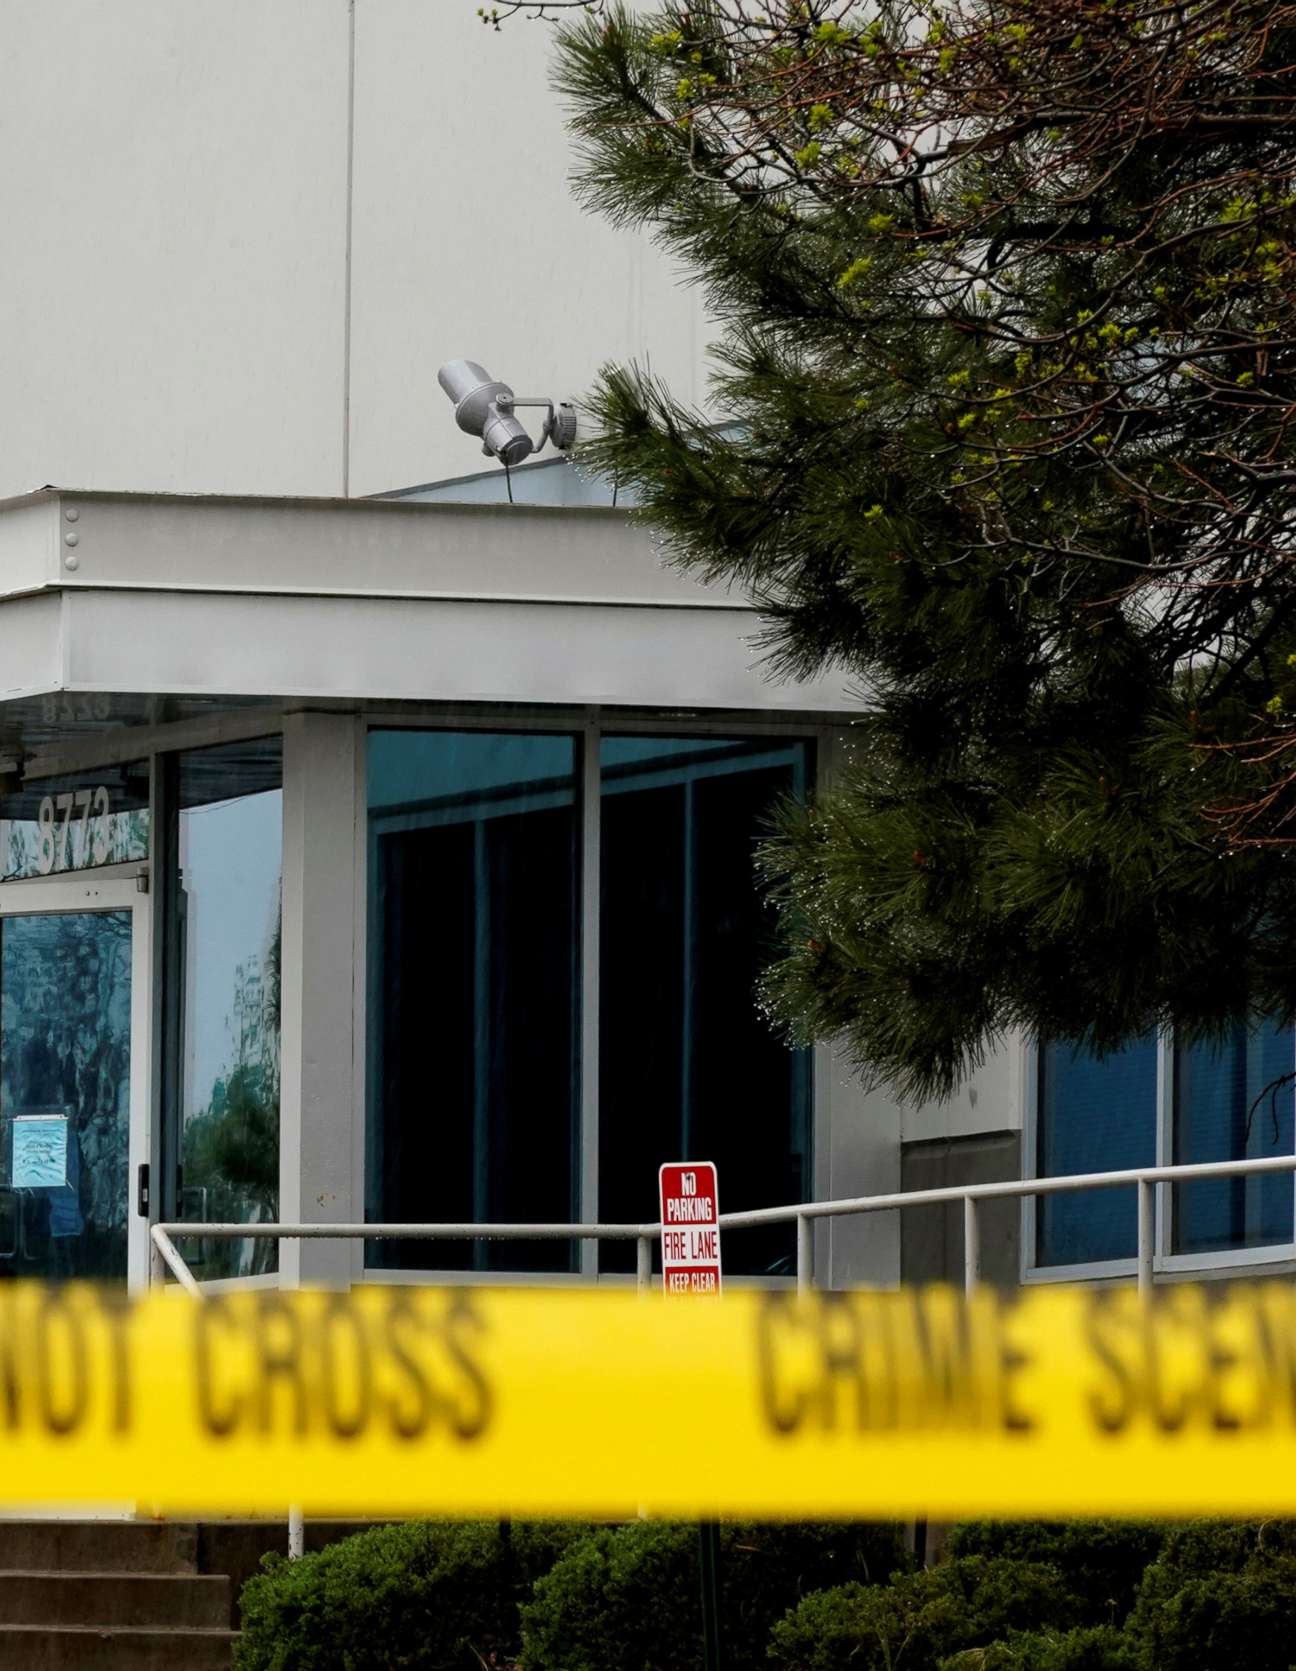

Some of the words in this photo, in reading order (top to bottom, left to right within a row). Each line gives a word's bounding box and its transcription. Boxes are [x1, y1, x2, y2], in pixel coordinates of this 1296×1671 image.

[39, 786, 110, 874] 8773
[680, 1172, 697, 1196] NO
[667, 1197, 712, 1222] PARKING
[664, 1231, 686, 1260] FIRE
[691, 1230, 718, 1259] LANE
[669, 1272, 689, 1293] KEEP
[691, 1272, 715, 1293] CLEAR
[194, 1286, 498, 1442] CROSS
[756, 1286, 1039, 1438] CRIME
